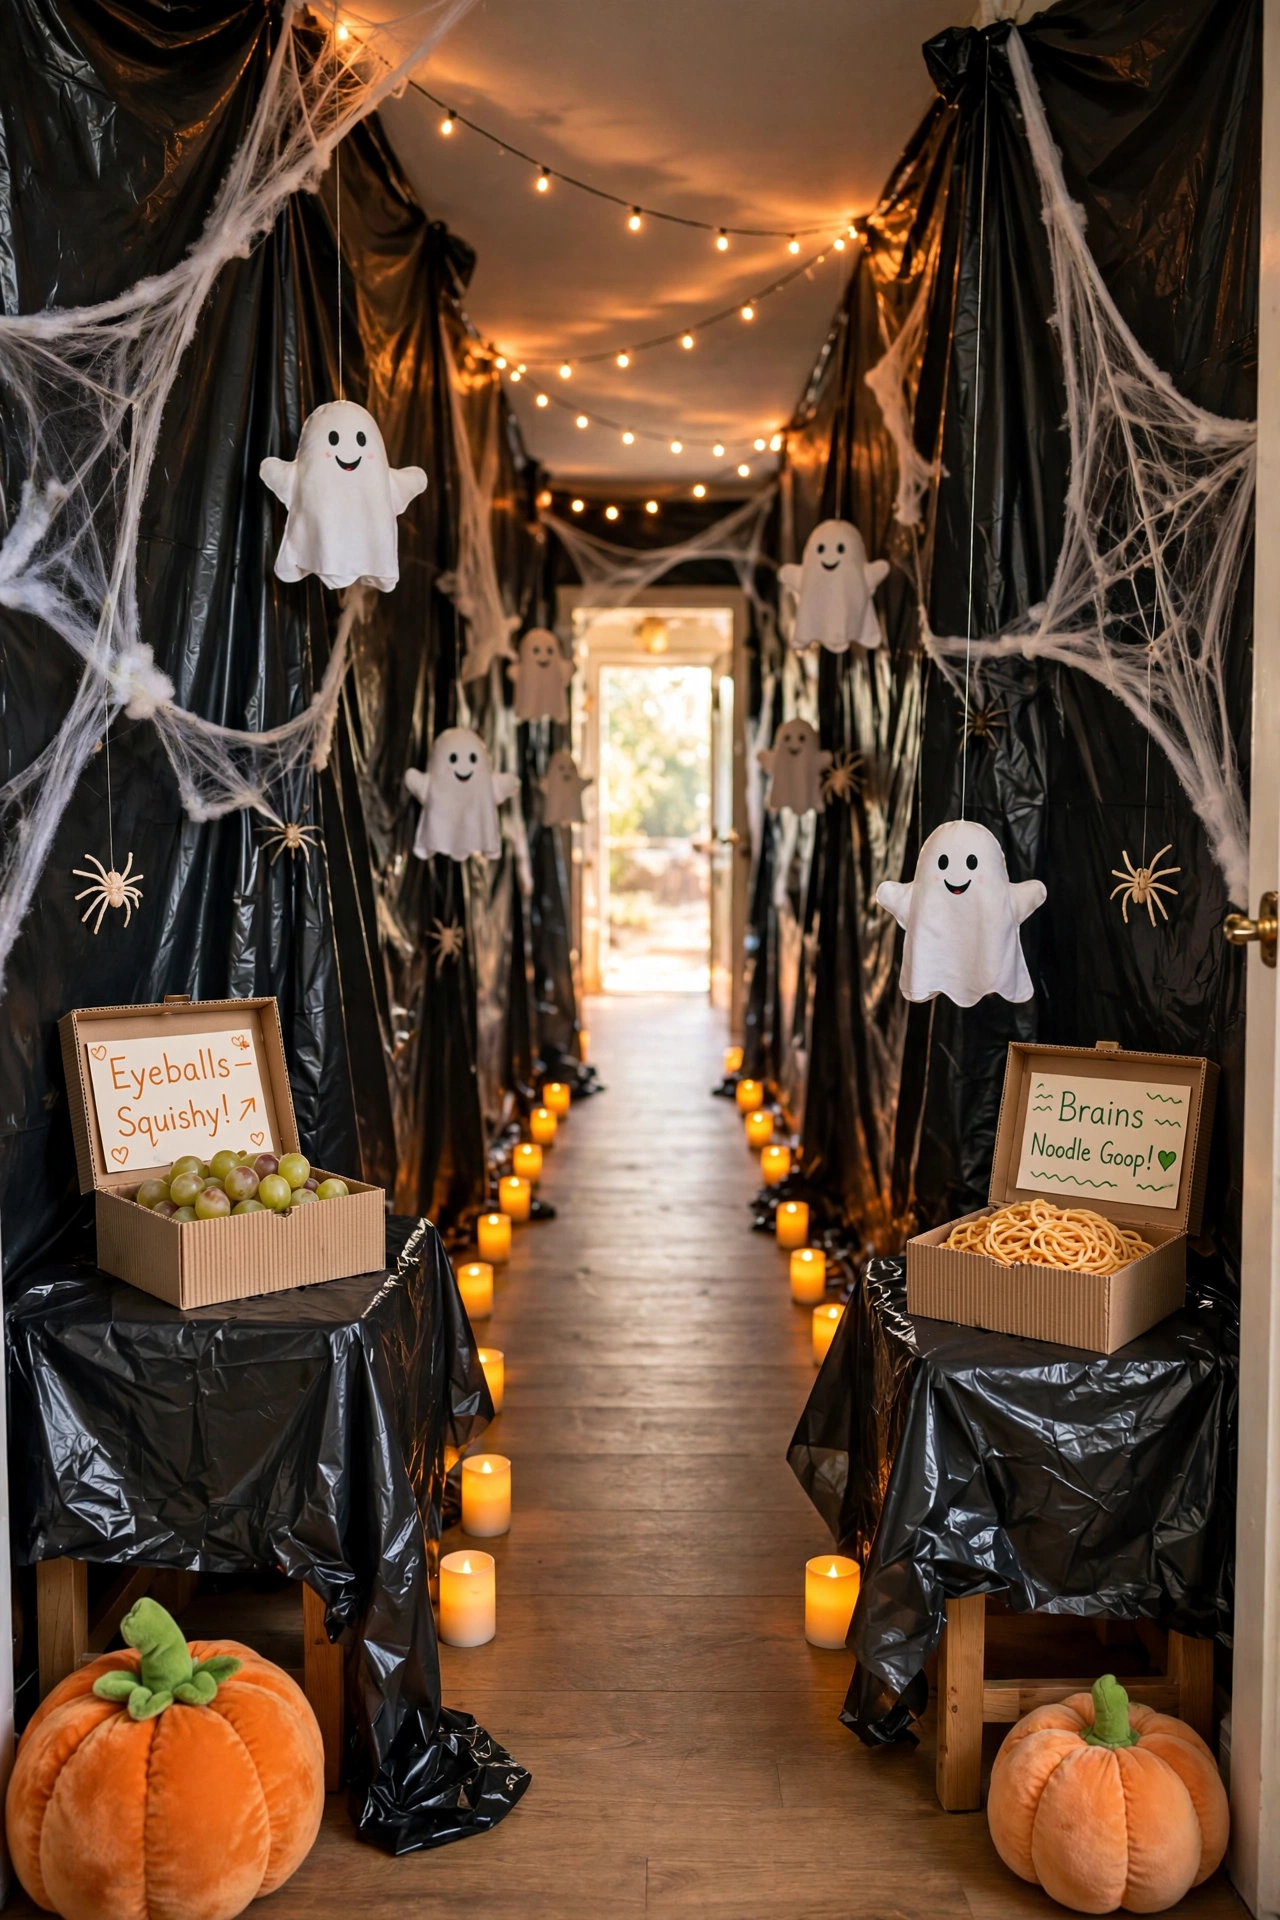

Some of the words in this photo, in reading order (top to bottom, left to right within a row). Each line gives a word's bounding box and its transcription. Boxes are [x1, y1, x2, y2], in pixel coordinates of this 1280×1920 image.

[117, 1093, 230, 1147] Squishy!
[1058, 1090, 1144, 1129] Brains
[1030, 1131, 1091, 1162] Noodle
[1100, 1140, 1154, 1177] Goop!
